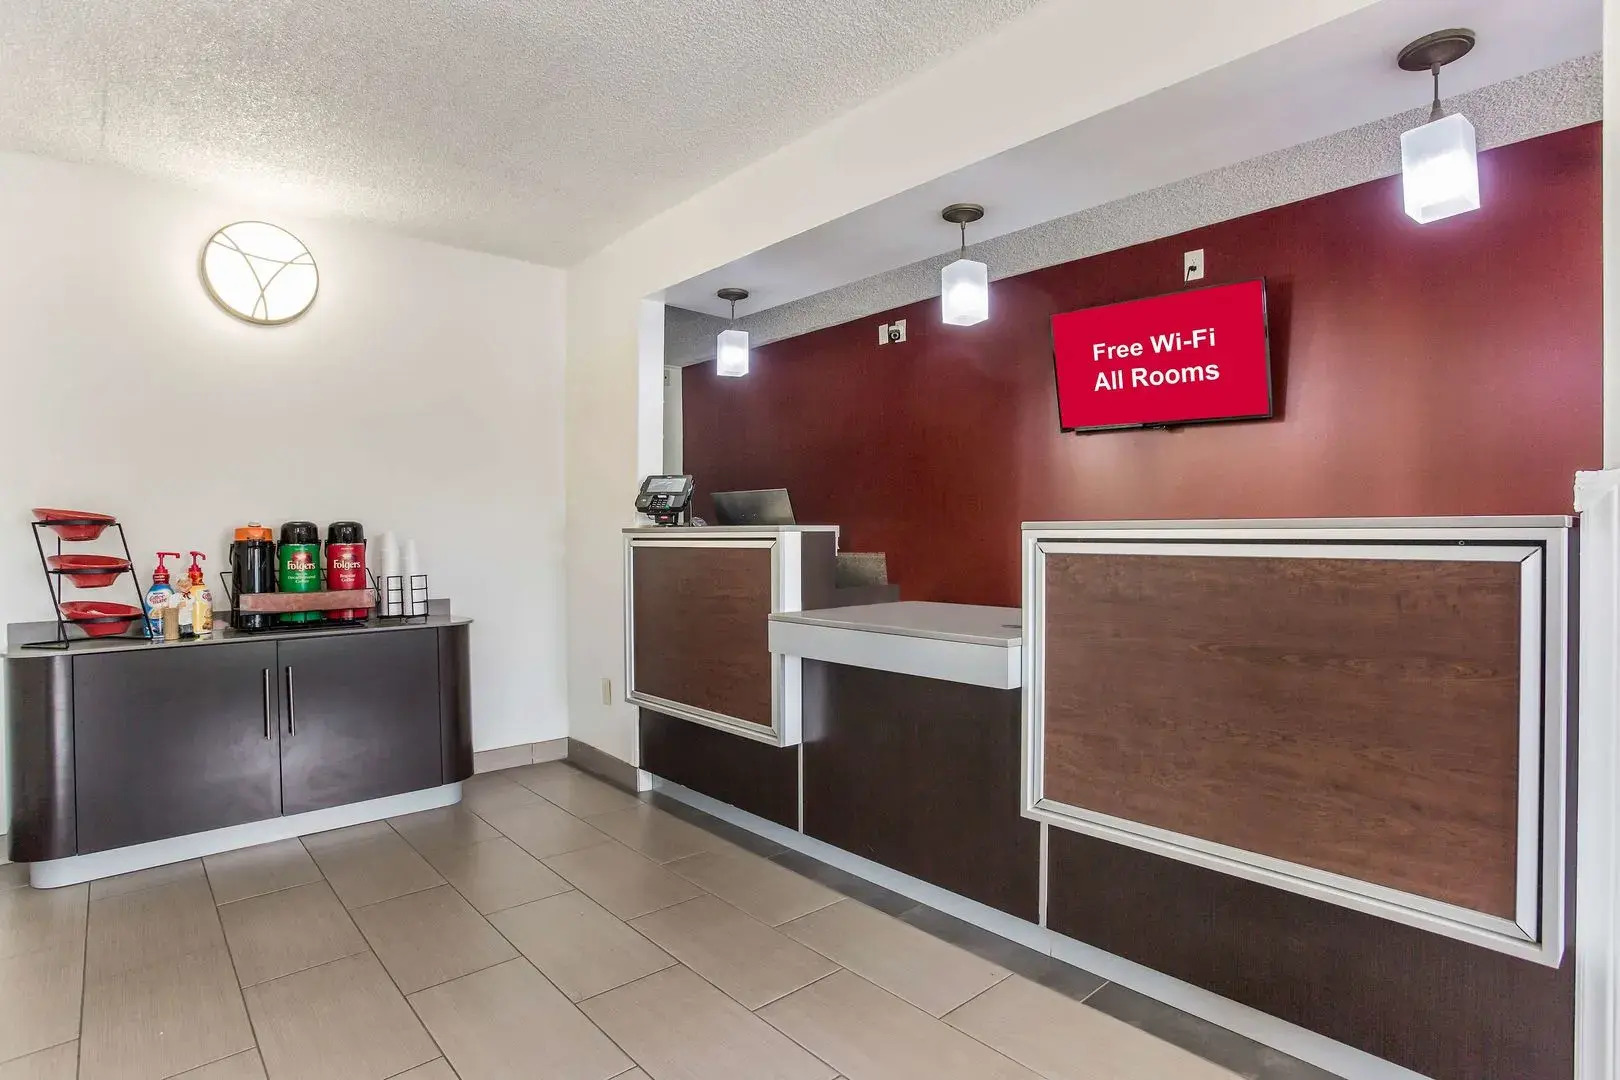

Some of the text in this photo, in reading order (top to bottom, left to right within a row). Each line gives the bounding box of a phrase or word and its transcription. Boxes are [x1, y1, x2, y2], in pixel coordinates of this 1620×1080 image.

[1092, 327, 1216, 361] Free Wi-Fi
[1094, 363, 1220, 391] All Rooms
[287, 560, 316, 571] Folgers
[333, 559, 361, 570] Folgers
